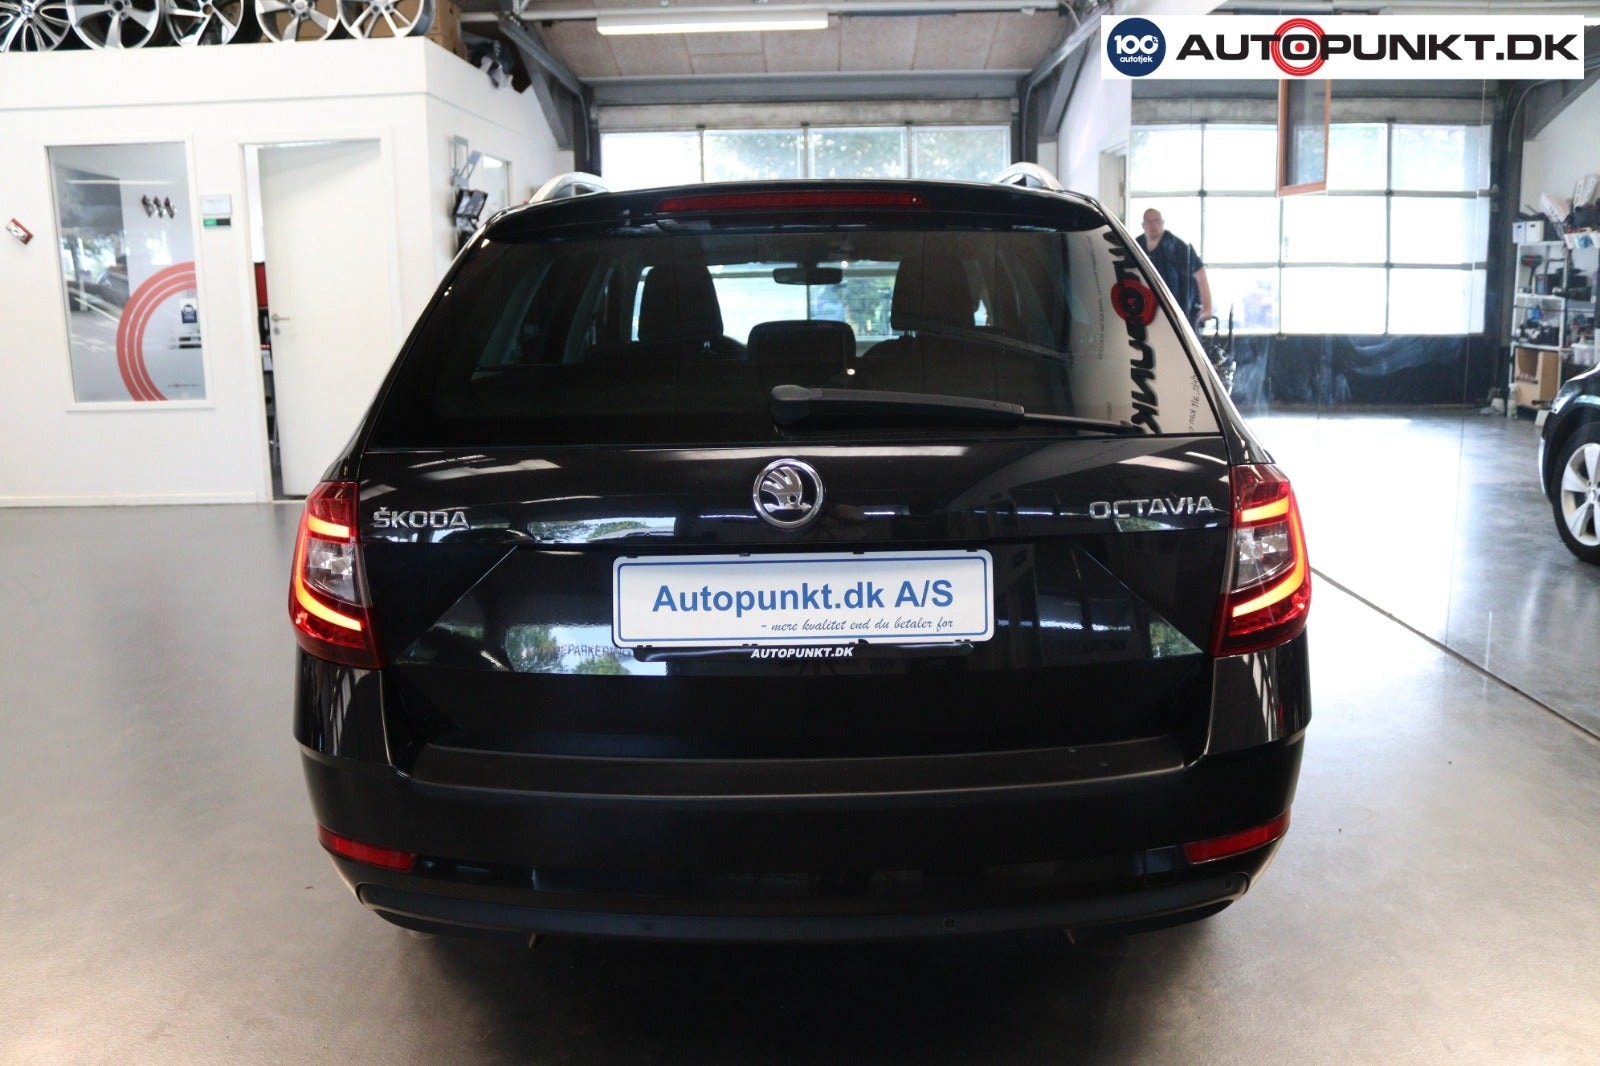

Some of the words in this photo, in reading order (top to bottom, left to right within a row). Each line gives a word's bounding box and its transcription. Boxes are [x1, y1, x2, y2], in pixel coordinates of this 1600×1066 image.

[372, 506, 470, 530] ŠKODA
[1089, 496, 1215, 520] OCTAVIA
[652, 581, 885, 618] Autopunkt.dk
[894, 579, 954, 608] A/S
[771, 621, 798, 632] mere
[802, 619, 846, 632] kvalitet
[850, 618, 872, 631] end
[874, 618, 892, 630] du
[894, 616, 932, 629] betaler
[936, 617, 954, 632] for
[750, 646, 854, 659] AUTOPUNKT.DK
